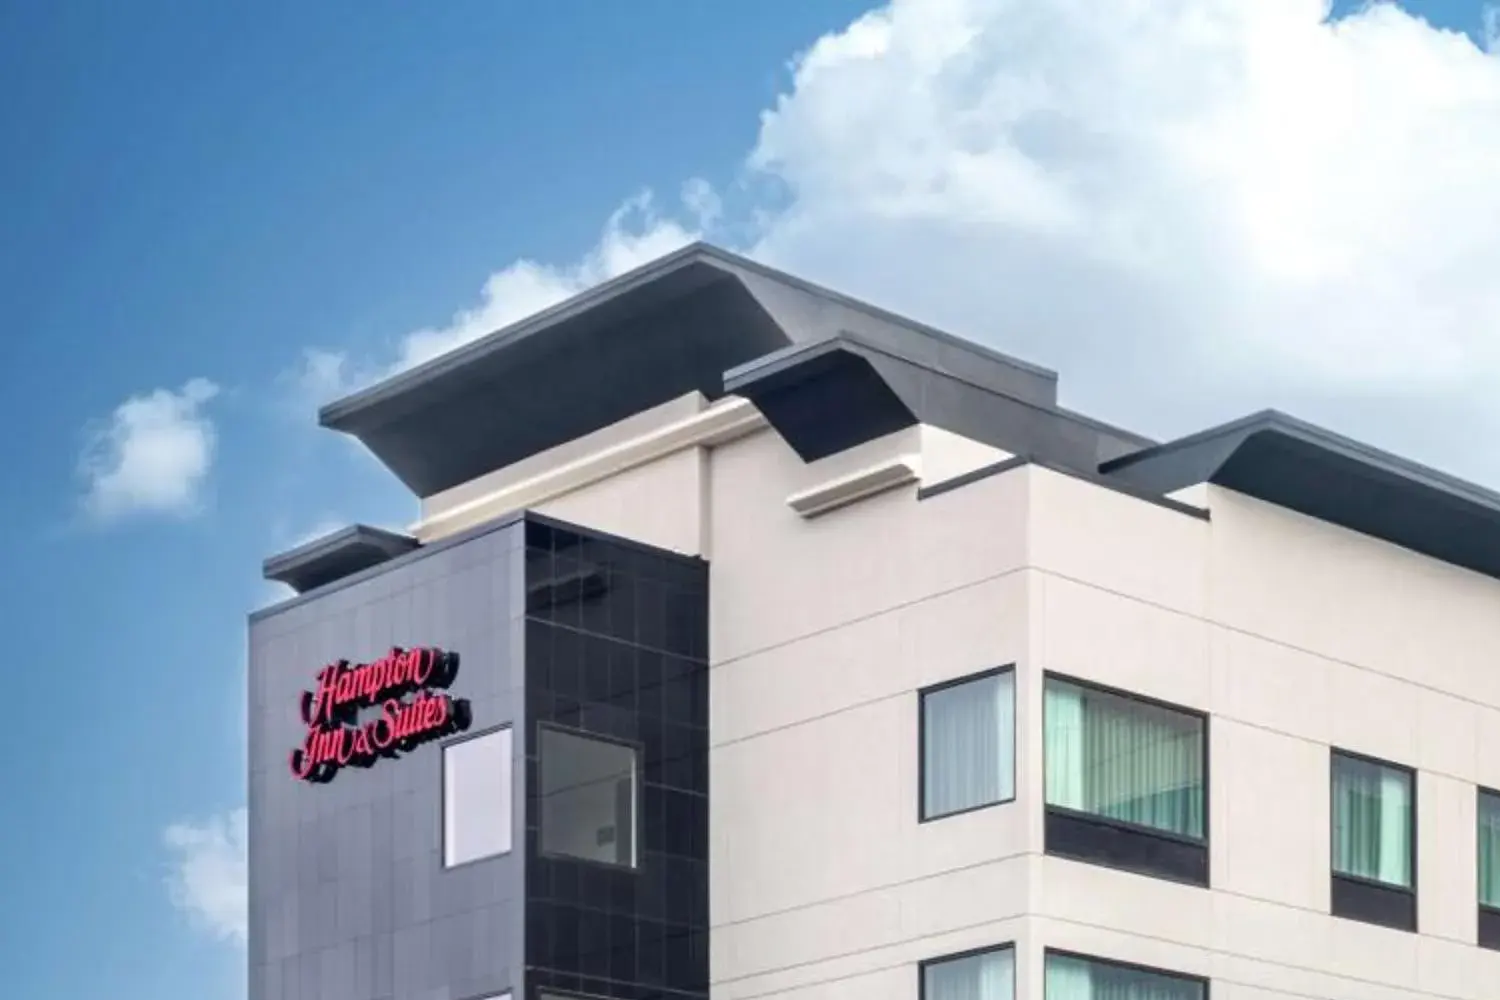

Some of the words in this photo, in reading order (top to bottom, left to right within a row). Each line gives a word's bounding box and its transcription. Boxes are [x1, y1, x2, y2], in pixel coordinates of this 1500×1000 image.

[302, 646, 440, 727] Hampton
[290, 725, 354, 779] Inn
[354, 727, 374, 755] &
[374, 691, 450, 747] Suites
